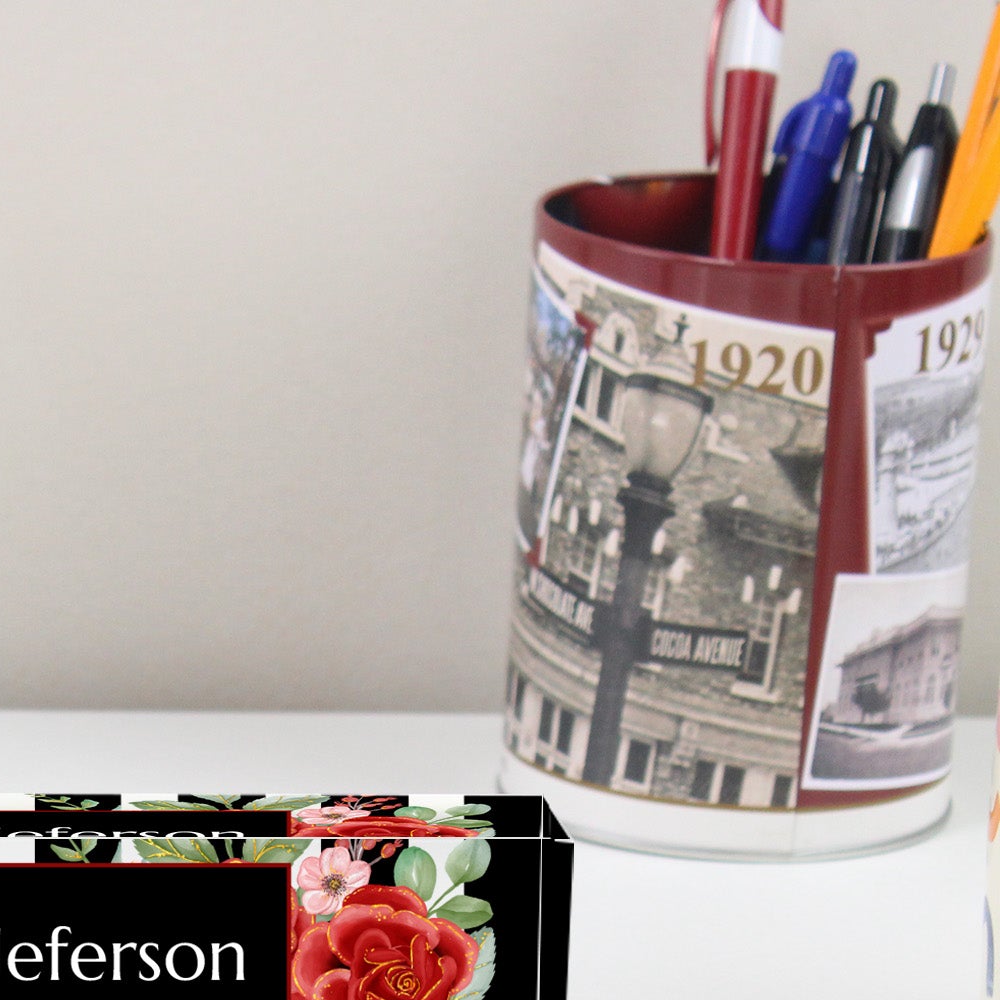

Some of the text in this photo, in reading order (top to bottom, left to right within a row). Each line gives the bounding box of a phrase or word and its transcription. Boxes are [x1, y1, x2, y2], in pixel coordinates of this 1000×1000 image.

[689, 339, 824, 396] 1920
[650, 629, 746, 668] COCOA AVENUE
